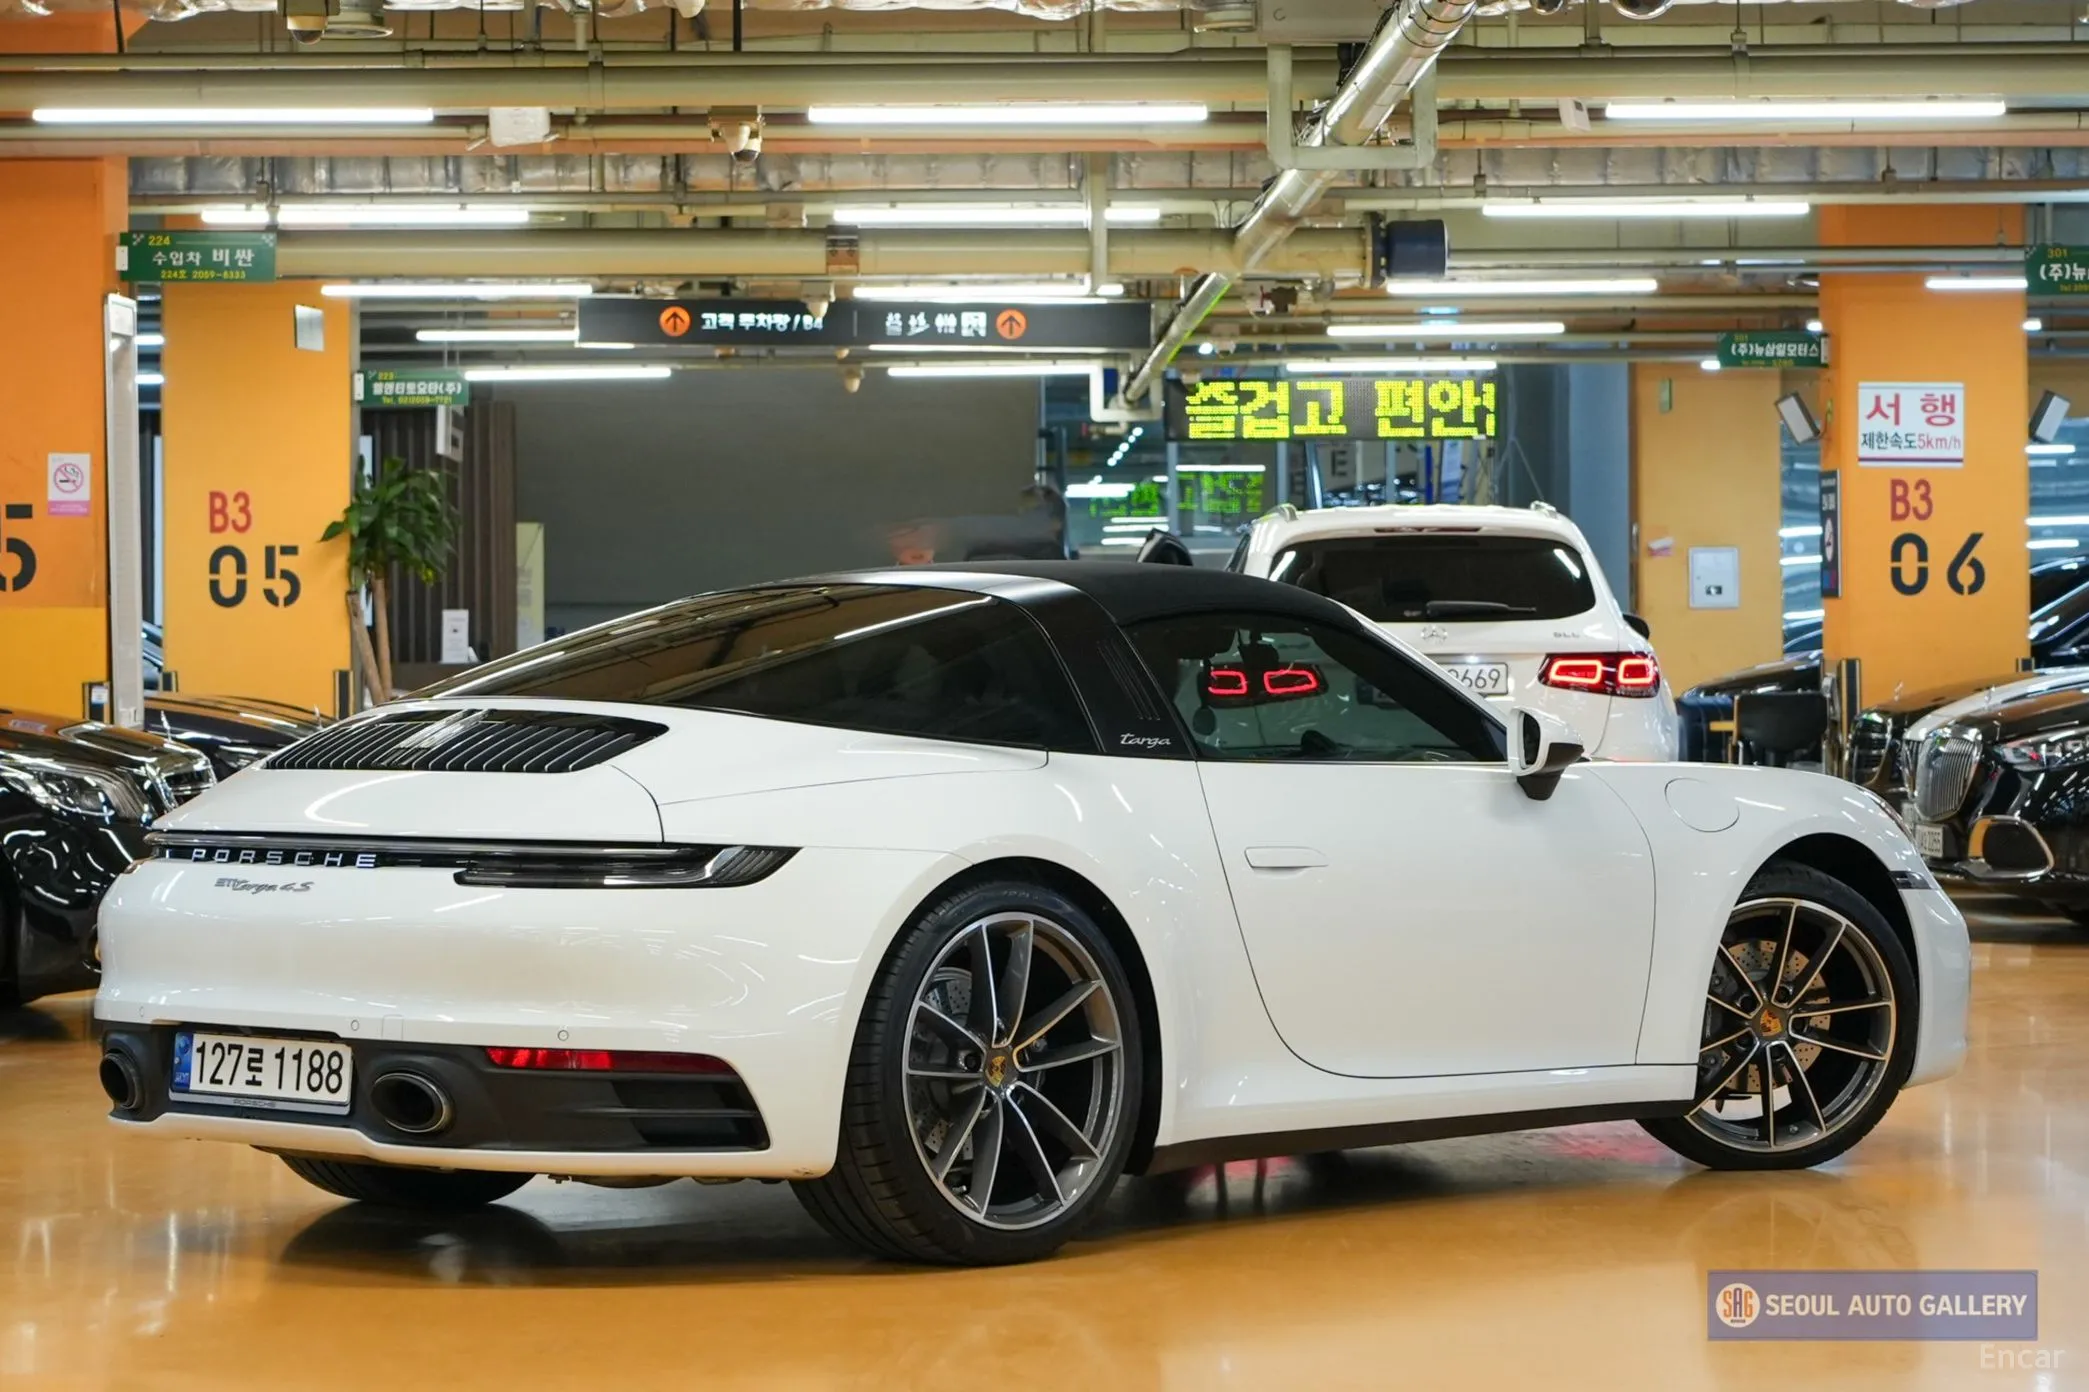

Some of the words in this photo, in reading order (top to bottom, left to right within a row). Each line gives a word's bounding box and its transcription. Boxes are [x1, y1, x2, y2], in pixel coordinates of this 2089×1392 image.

[148, 235, 171, 246] 224
[152, 251, 202, 267] 수입차
[211, 248, 255, 267] 비싼
[2040, 262, 2089, 281] (주)뉴
[1185, 381, 1347, 439] 즐겁고
[1374, 380, 1496, 438] 편안
[209, 490, 252, 534] B3
[1890, 478, 1933, 521] B3
[209, 544, 302, 608] 05
[1890, 532, 1985, 597] 06
[190, 847, 377, 869] PORSCHE
[195, 1040, 265, 1087] 127로
[274, 1046, 344, 1095] 1188
